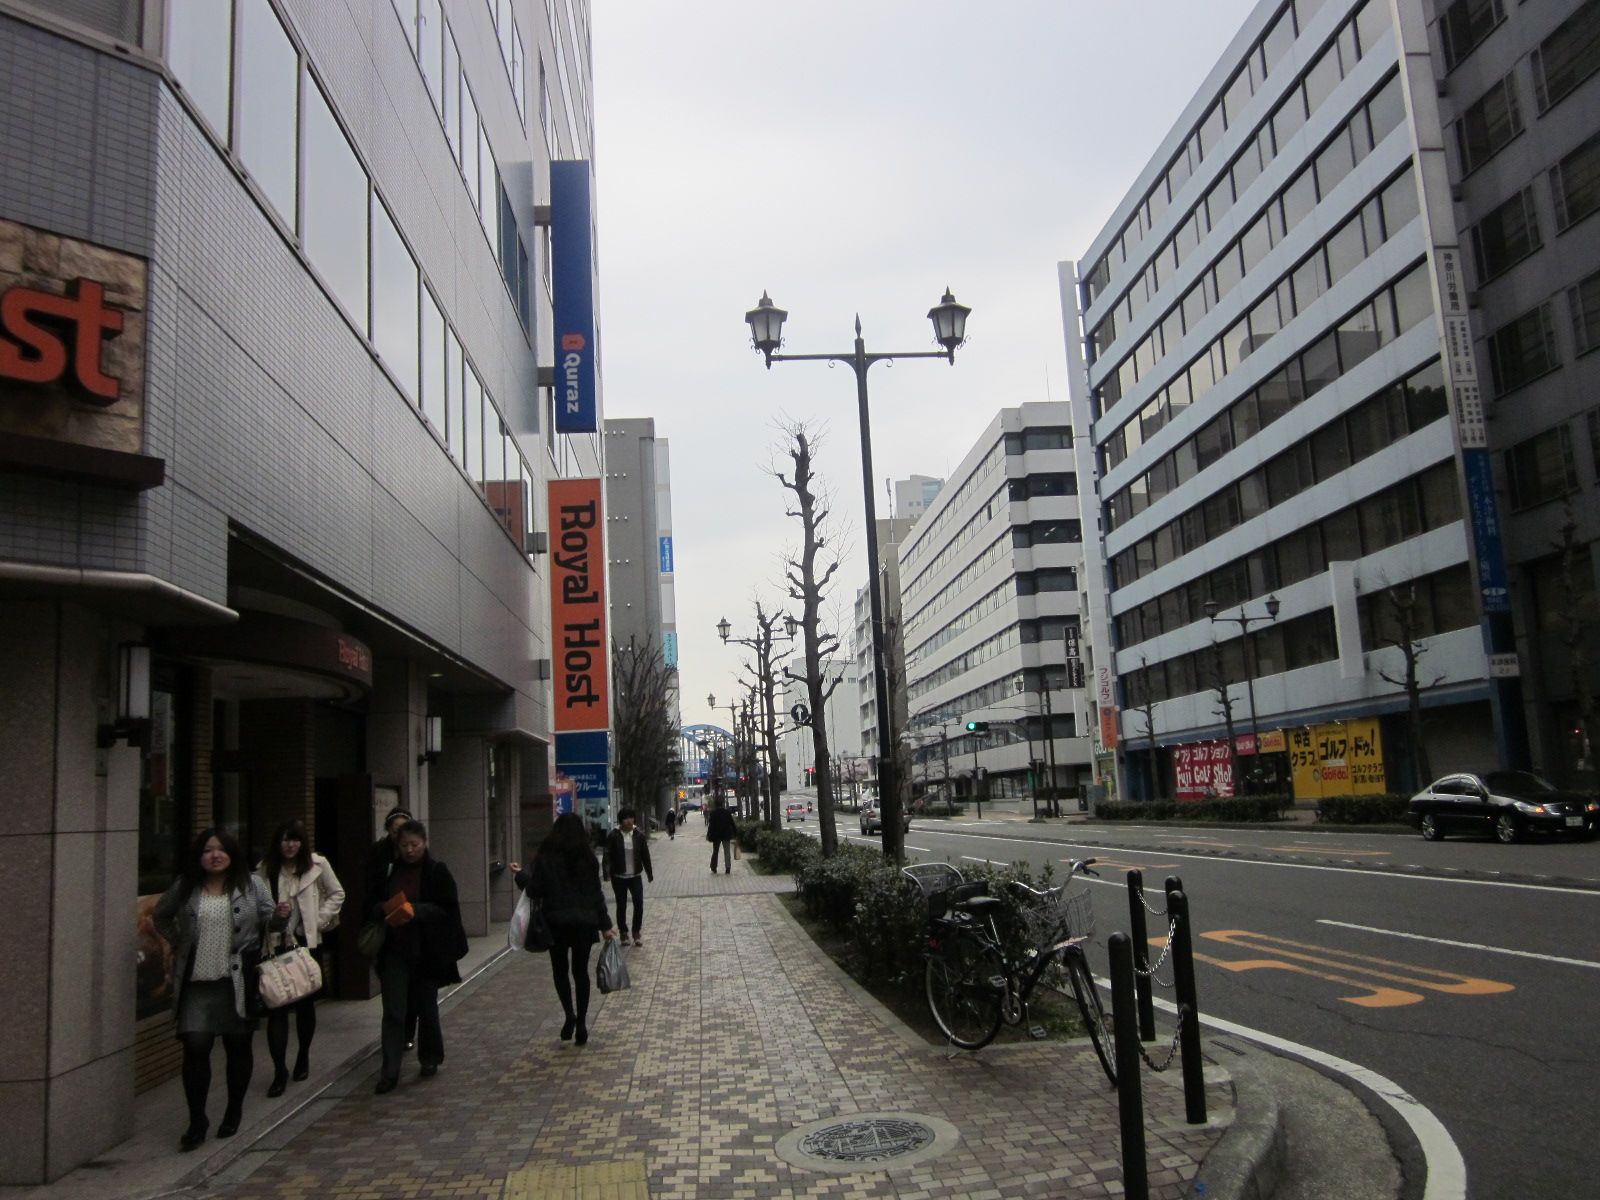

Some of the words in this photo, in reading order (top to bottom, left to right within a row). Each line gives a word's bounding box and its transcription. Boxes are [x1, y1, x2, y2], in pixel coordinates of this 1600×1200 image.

[562, 352, 582, 414] Quraz
[554, 499, 599, 605] Royal
[563, 619, 600, 709] Host
[1294, 730, 1310, 747] 中古
[1176, 764, 1192, 787] Fuji
